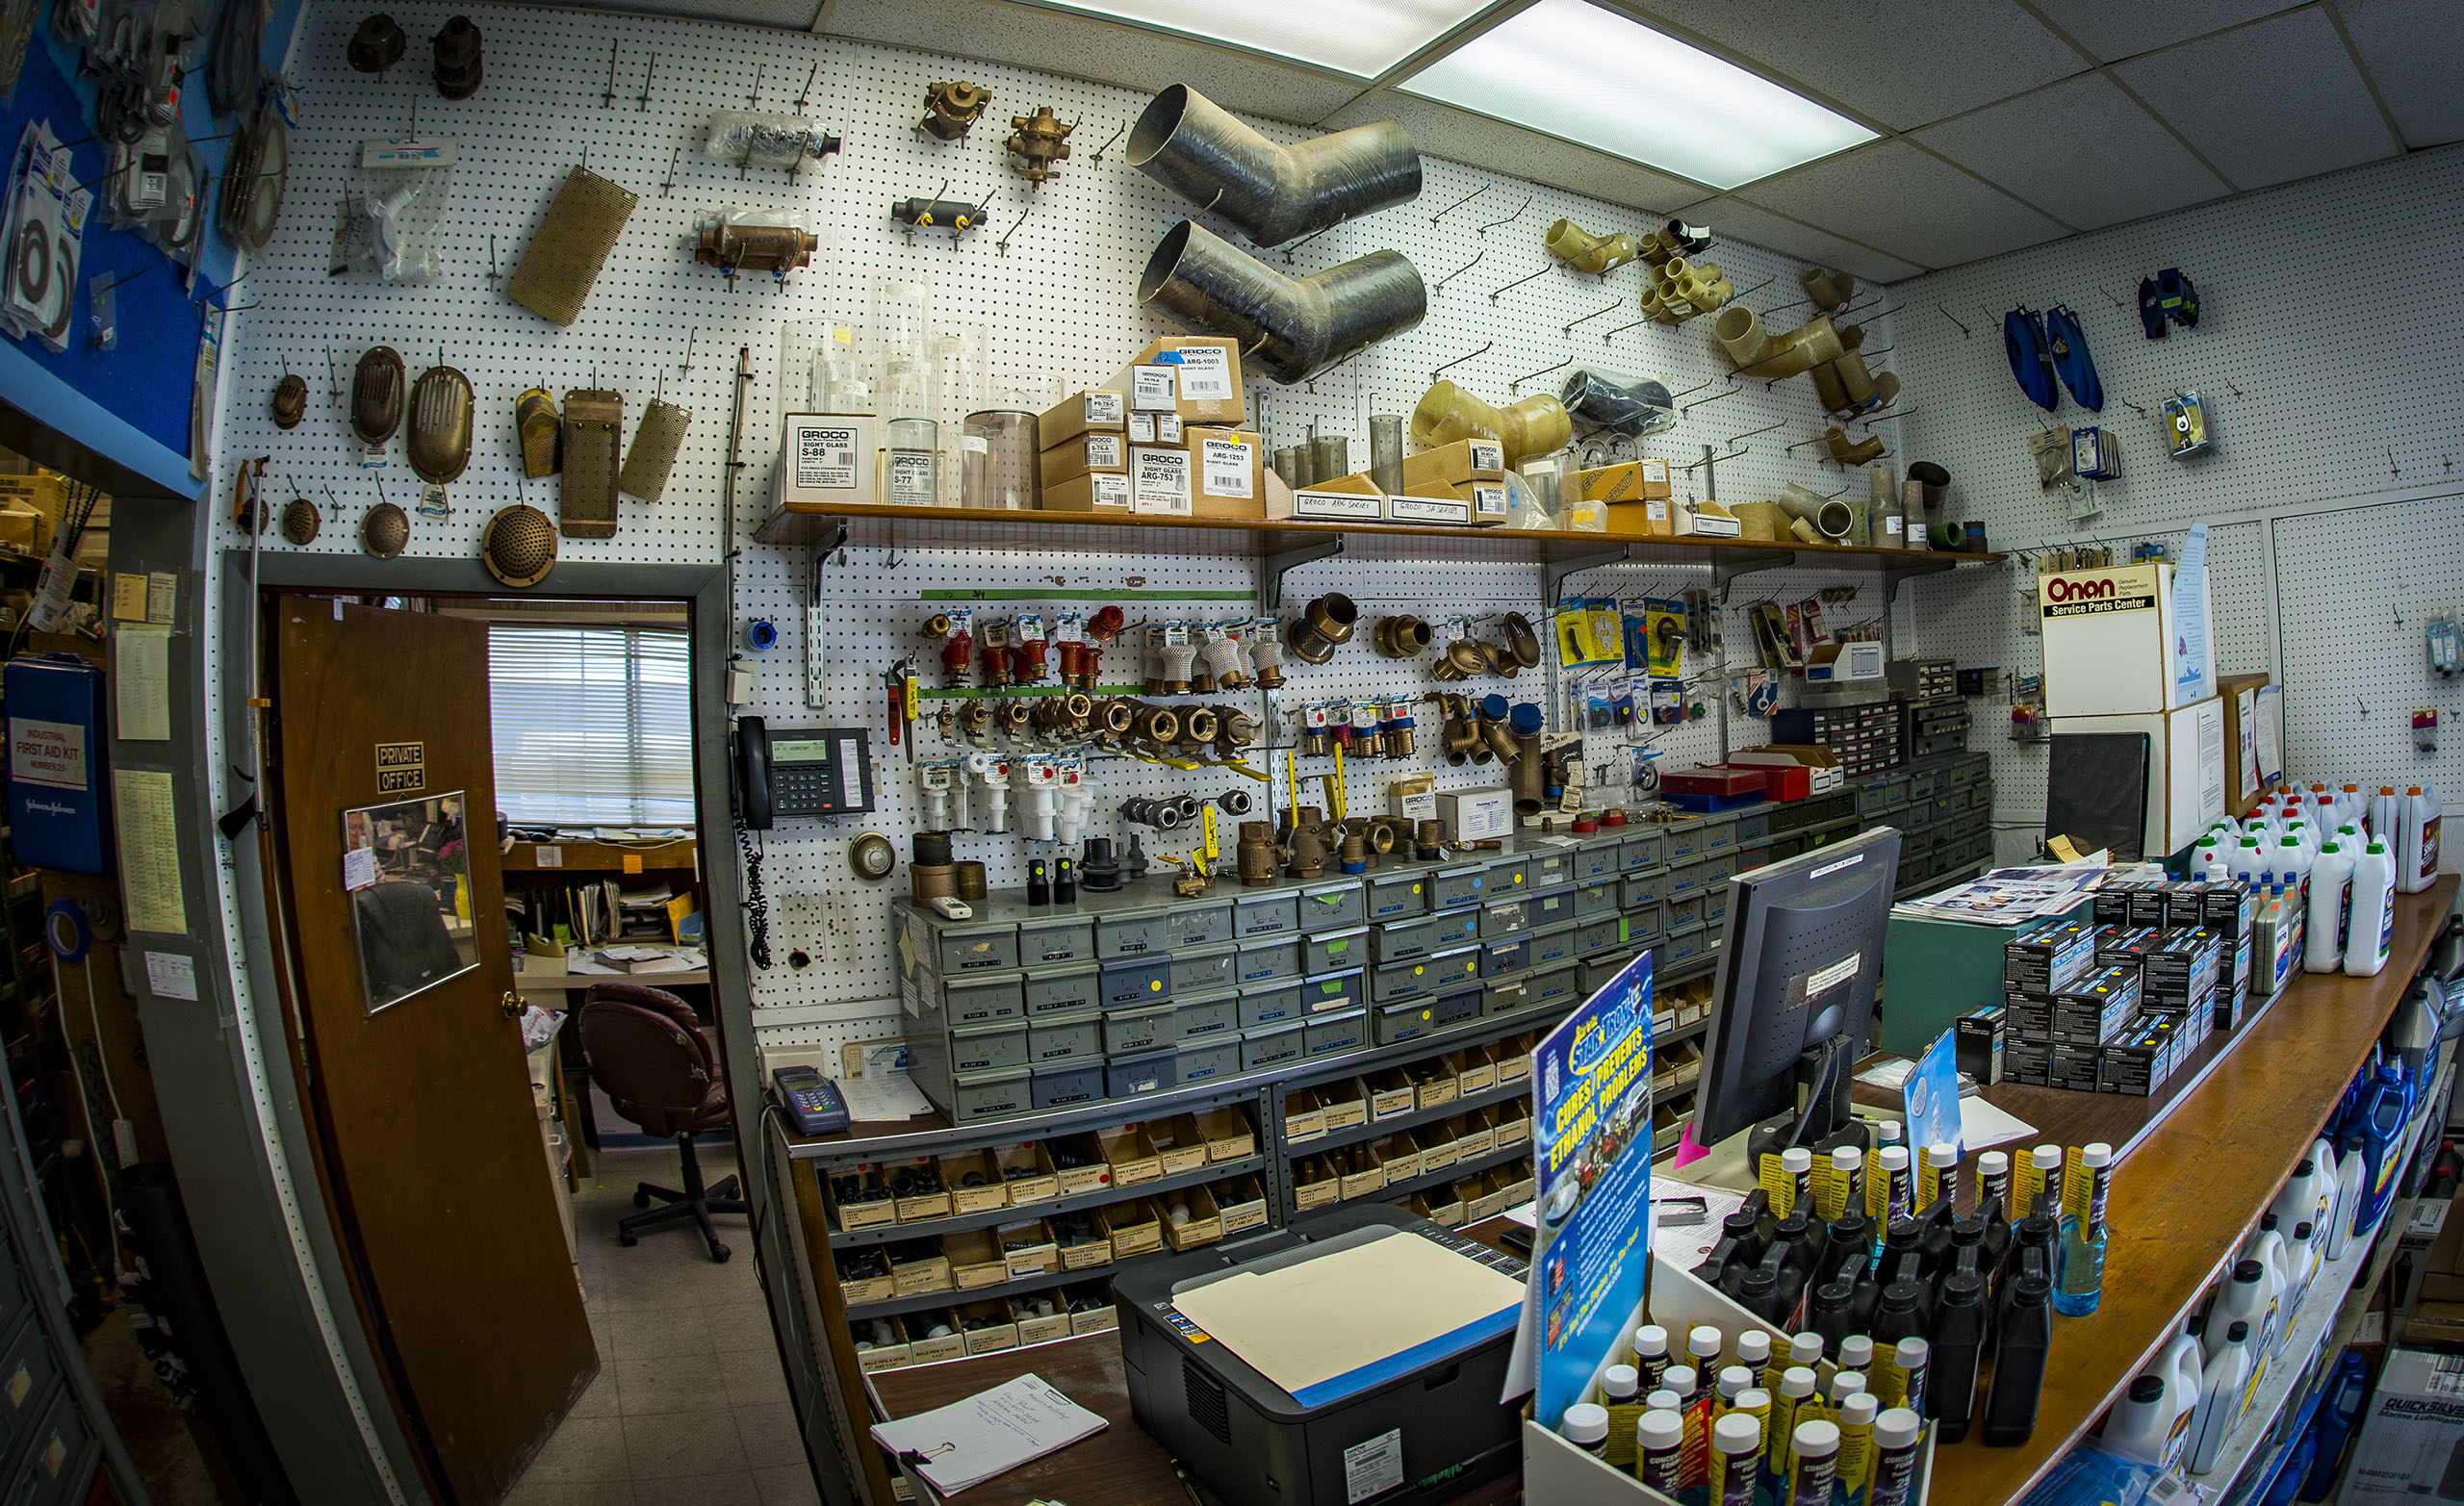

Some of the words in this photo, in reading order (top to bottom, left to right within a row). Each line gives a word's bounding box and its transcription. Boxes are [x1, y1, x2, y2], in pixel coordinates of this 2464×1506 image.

[802, 430, 850, 439] GROCO
[1206, 441, 1247, 451] GROCO
[802, 447, 826, 456] S-88
[1213, 451, 1245, 461] ARG-1253
[893, 456, 929, 466] GROCO
[1142, 454, 1183, 465] GROCO
[1142, 472, 1173, 481] ARG-753
[1304, 498, 1326, 507] GROCO
[1332, 499, 1346, 508] ARG
[2118, 577, 2138, 586] Genuine
[2047, 577, 2116, 602] Onan
[2118, 582, 2149, 592] Replacement
[2052, 604, 2087, 616] Service
[2088, 601, 2114, 613] Parts
[2115, 598, 2146, 610] Center
[1612, 682, 1629, 691] PERKO
[27, 728, 66, 742] INDUSTRIAL
[1546, 738, 1559, 747] FLUSH
[16, 742, 43, 756] FIRST
[43, 745, 61, 758] AID
[63, 747, 79, 760] KIT
[379, 746, 422, 765] PRIVATE
[30, 759, 57, 771] NUMBER
[57, 763, 66, 772] 25
[382, 770, 422, 789] OFFICE
[1404, 794, 1434, 804] GROCO
[1556, 1024, 1643, 1135] CURES/PREVENTS
[1550, 1103, 1598, 1174] ETHANOL
[1599, 1045, 1648, 1115] PROBLEMS
[910, 1268, 932, 1277] ADAPTERS
[2377, 1410, 2413, 1420] Marine
[2413, 1414, 2464, 1426] Lubricants
